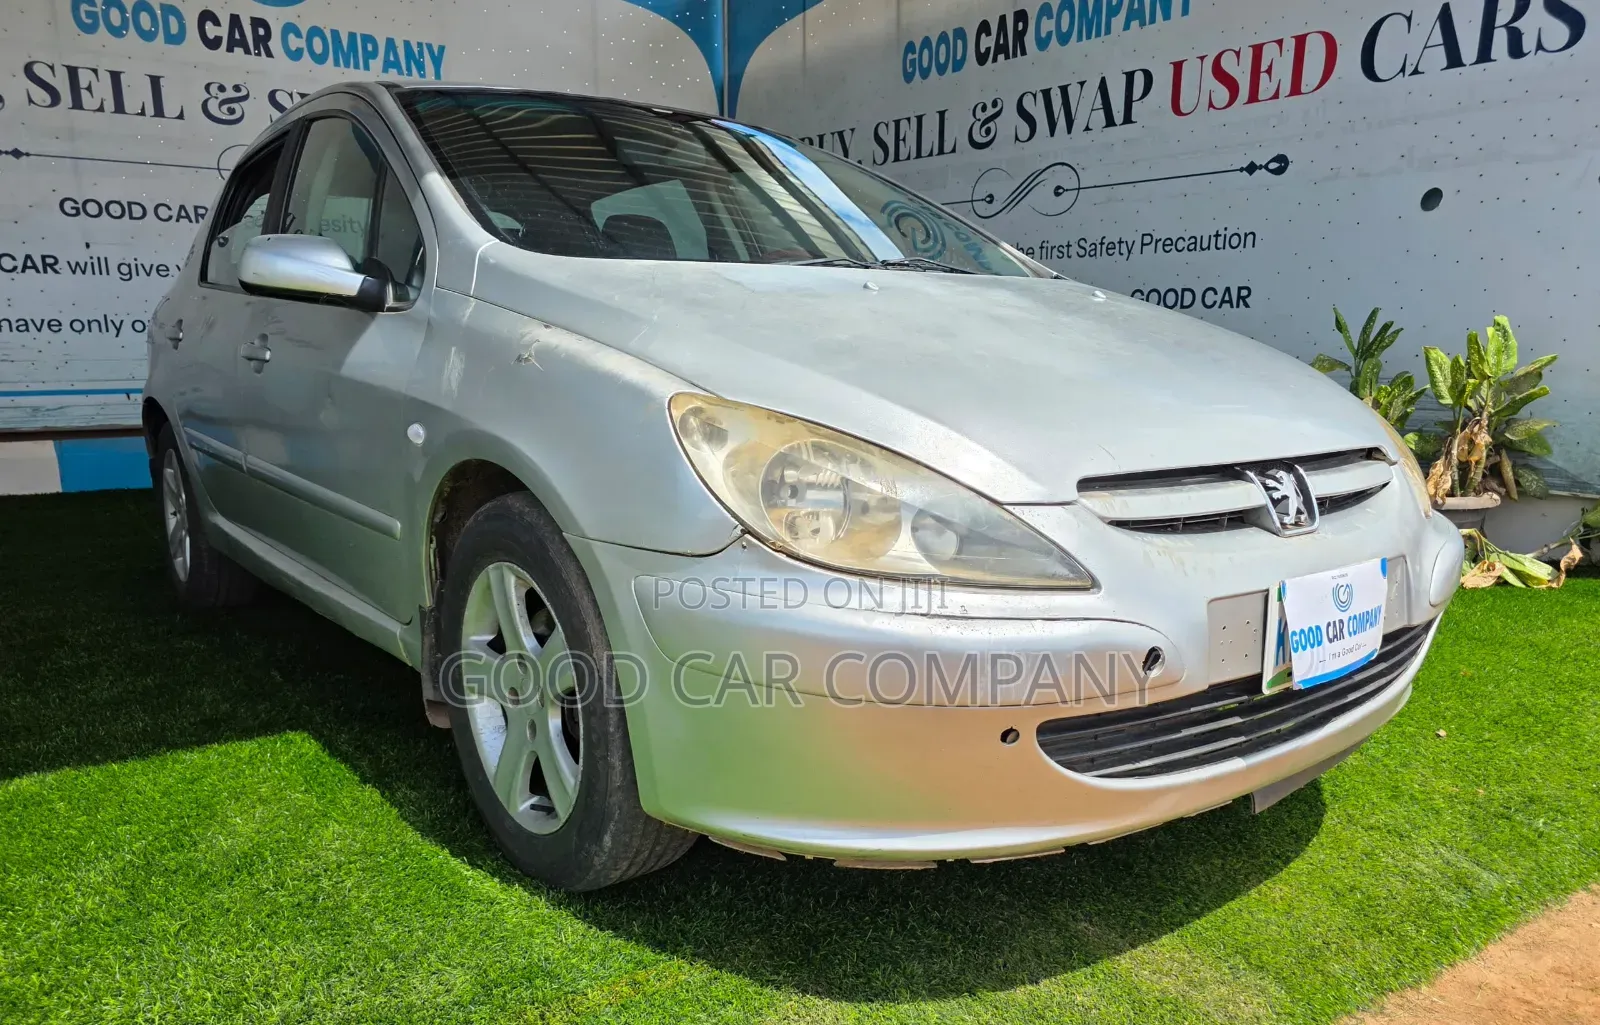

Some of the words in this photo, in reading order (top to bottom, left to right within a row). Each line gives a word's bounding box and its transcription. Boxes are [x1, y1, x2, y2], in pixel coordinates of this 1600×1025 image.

[70, 0, 187, 46] GOOD
[197, 9, 275, 59] CAR
[280, 22, 446, 81] COMPANY
[902, 26, 968, 85] GOOD
[974, 8, 1029, 67] CAR
[23, 60, 185, 121] SELL
[201, 81, 250, 126] &
[872, 109, 957, 167] SELL
[967, 97, 1004, 150] &
[1014, 68, 1154, 144] SWAP
[1169, 30, 1338, 117] USED
[1360, 0, 1586, 83] CARS
[58, 196, 148, 221] GOOD
[0, 252, 61, 275] CAR
[66, 256, 111, 276] will
[1039, 239, 1072, 261] first
[1076, 235, 1136, 262] Safety
[1140, 227, 1257, 255] Precaution
[1201, 285, 1252, 310] CAR
[69, 314, 124, 338] only
[1290, 625, 1323, 654] GOOD
[1325, 618, 1345, 644] CAR
[1347, 604, 1383, 638] COMPANY
